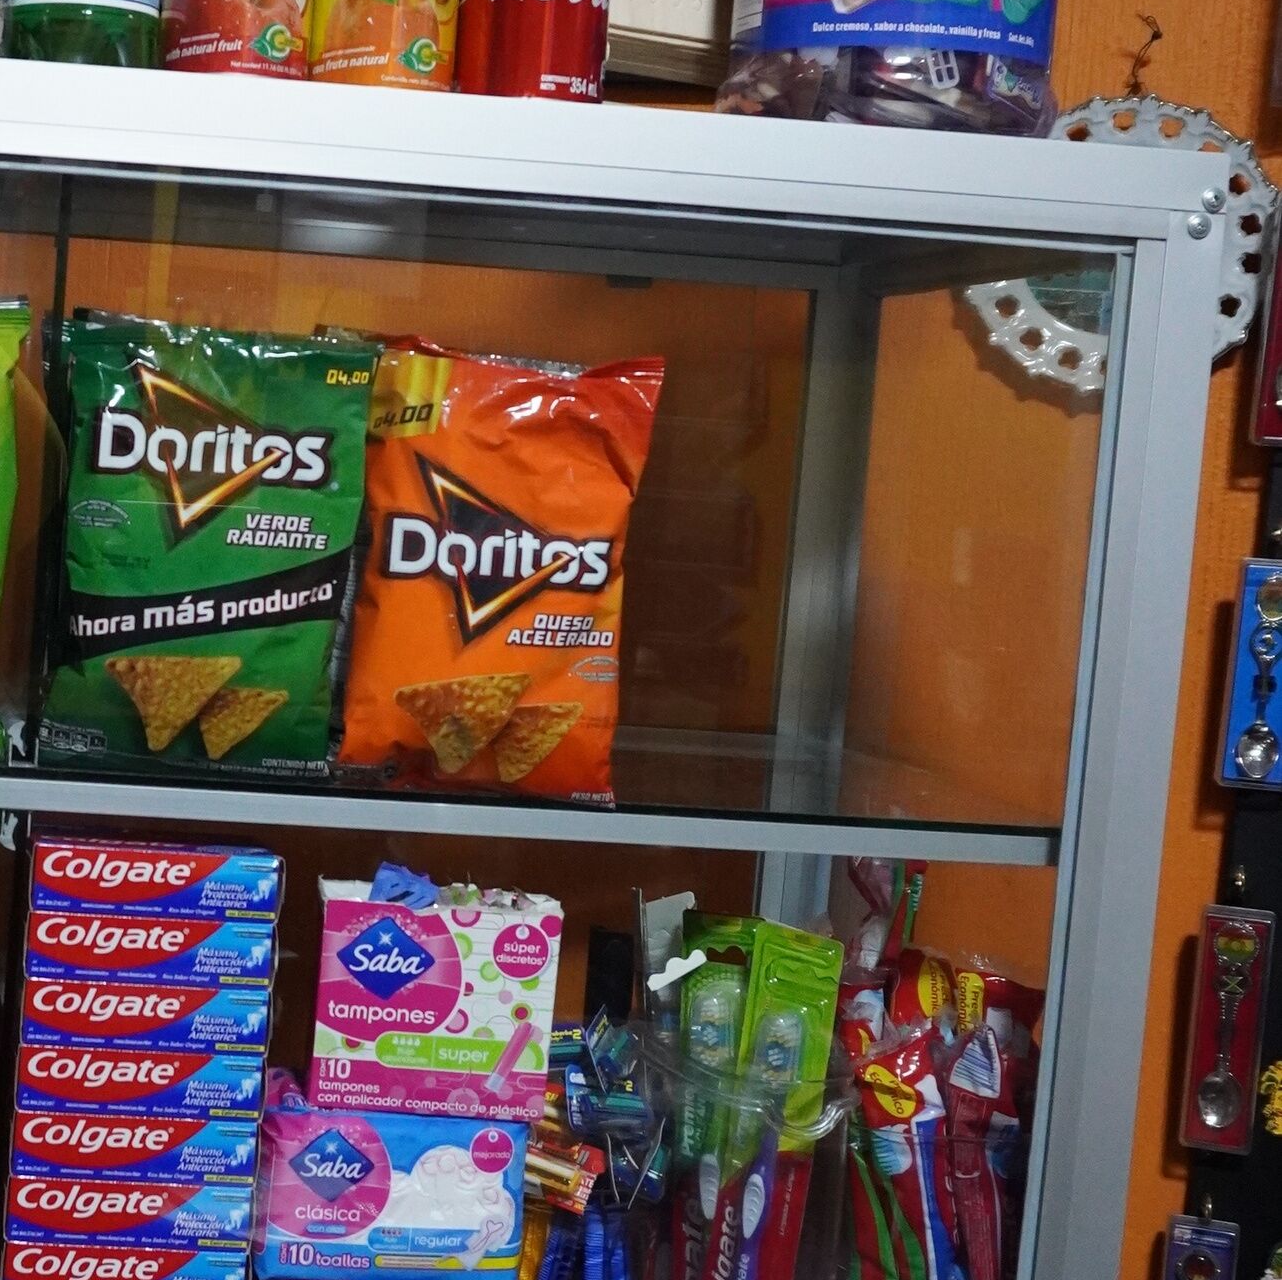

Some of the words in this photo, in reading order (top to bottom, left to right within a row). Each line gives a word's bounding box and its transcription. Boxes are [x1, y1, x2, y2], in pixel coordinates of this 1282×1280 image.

[813, 22, 835, 32] Dulce
[874, 21, 898, 32] sabor
[217, 38, 244, 54] fruit
[570, 75, 587, 95] 354
[96, 408, 329, 485] Doritos
[243, 512, 313, 533] VERDE
[226, 530, 328, 551] RADIANTE
[387, 516, 613, 587] Doritos
[142, 594, 215, 631] más
[533, 613, 596, 633] QUESO
[506, 628, 617, 649] ACELERADO
[42, 850, 192, 888] Colgate
[202, 889, 256, 902] Protección
[204, 880, 246, 892] Máximo
[198, 898, 248, 910] Anticaries
[36, 917, 186, 954] Colgate
[198, 947, 239, 959] Máximo
[503, 941, 541, 956] súper
[195, 955, 249, 968] Protección
[349, 943, 426, 975] Saba
[192, 965, 242, 975] Anticaries
[32, 985, 182, 1022] Colgate
[327, 999, 436, 1026] tampones
[438, 1046, 490, 1065] super
[27, 1051, 176, 1088] Colgate
[327, 1059, 351, 1079] 10
[318, 1080, 381, 1095] tampones
[317, 1093, 341, 1104] con
[343, 1093, 403, 1108] aplicador
[405, 1098, 468, 1114] compacto
[469, 1102, 488, 1114] de
[489, 1103, 539, 1121] plástico
[22, 1117, 170, 1153] Colgate
[471, 1148, 512, 1161] mejorado
[299, 1152, 367, 1180] Saba
[16, 1182, 164, 1219] Colgate
[294, 1203, 361, 1223] clásica
[414, 1234, 462, 1249] regular
[315, 1254, 370, 1270] toallas
